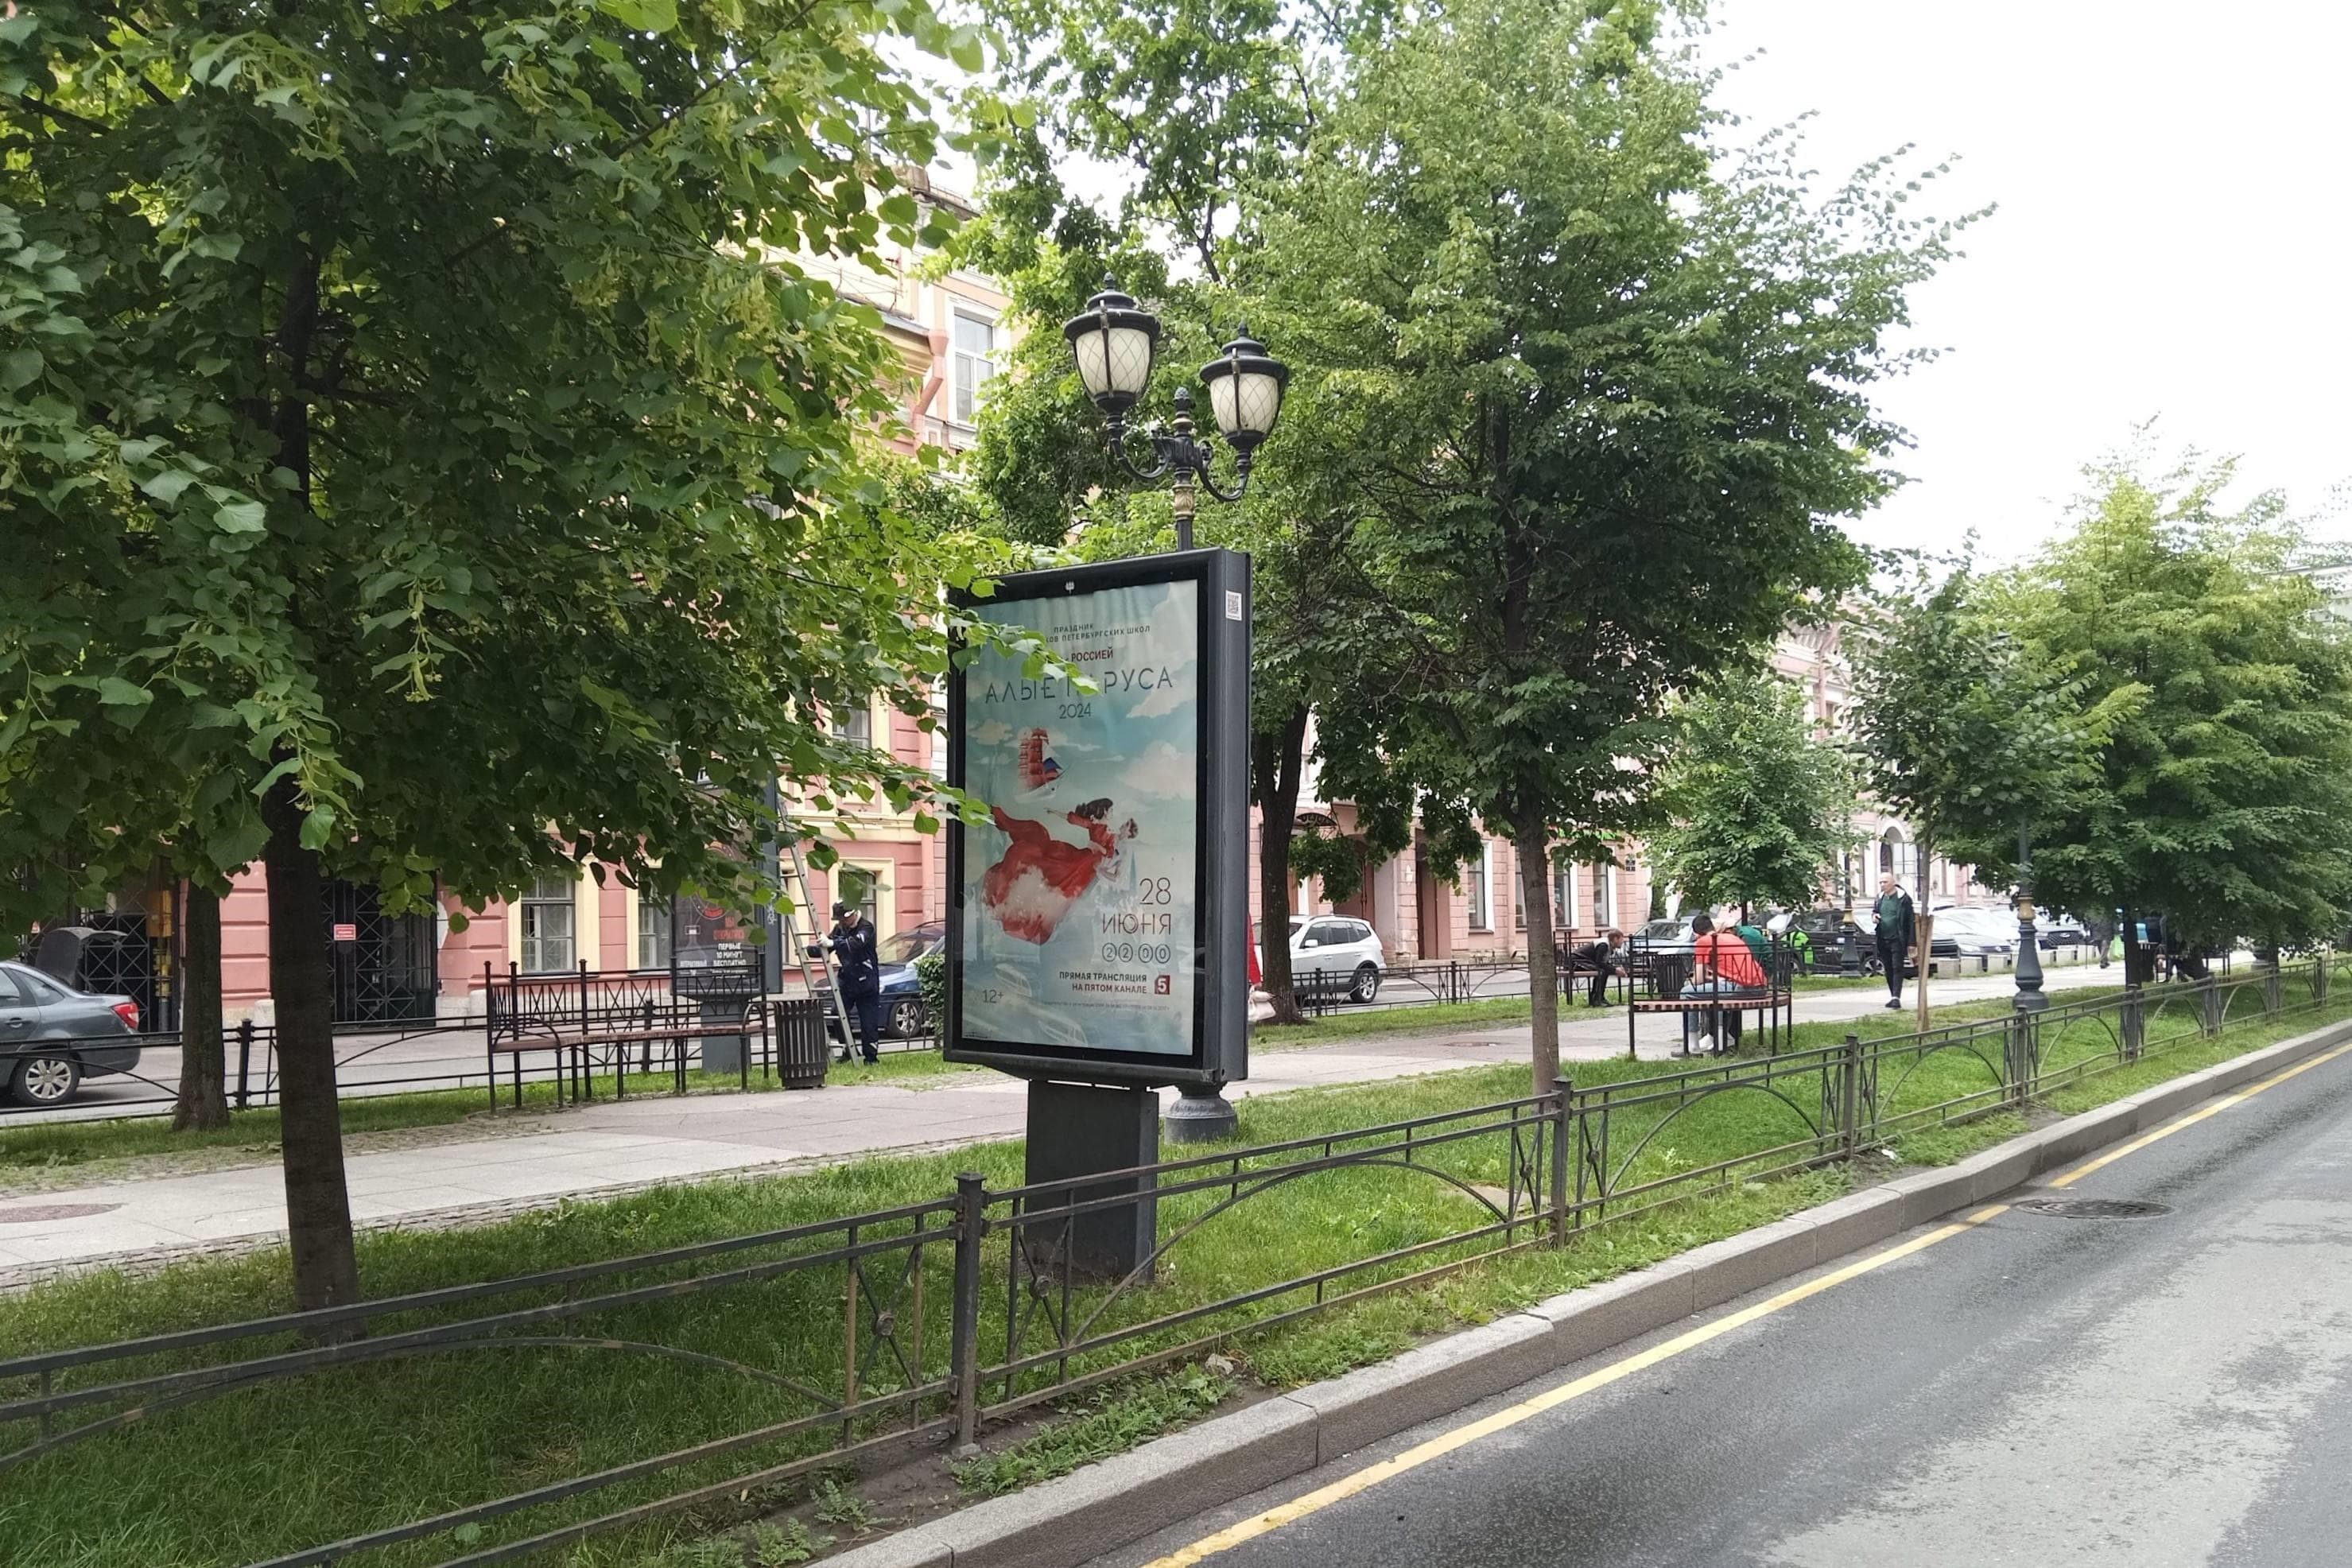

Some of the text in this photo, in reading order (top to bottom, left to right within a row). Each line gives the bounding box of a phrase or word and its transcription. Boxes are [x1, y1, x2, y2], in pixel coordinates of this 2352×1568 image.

[1054, 623, 1094, 634] ПРАЗДНИК
[1062, 628, 1124, 642] ПЕТЕРБУРГСКИХ
[1127, 625, 1151, 634] ШКОЛ
[1071, 646, 1114, 662] РОССИЕЙ
[985, 666, 1173, 704] АЛЫЕ РУСА
[1059, 703, 1092, 720] 2024
[1139, 877, 1171, 905] 28
[1102, 913, 1171, 935] ИЮНЯ
[1059, 971, 1147, 983] ПРЯМАЯ ТРАНСЛЯЦИЯ
[1157, 976, 1167, 993] 5
[982, 989, 1003, 1003] 12+
[1085, 984, 1112, 992] ПЯТОМ
